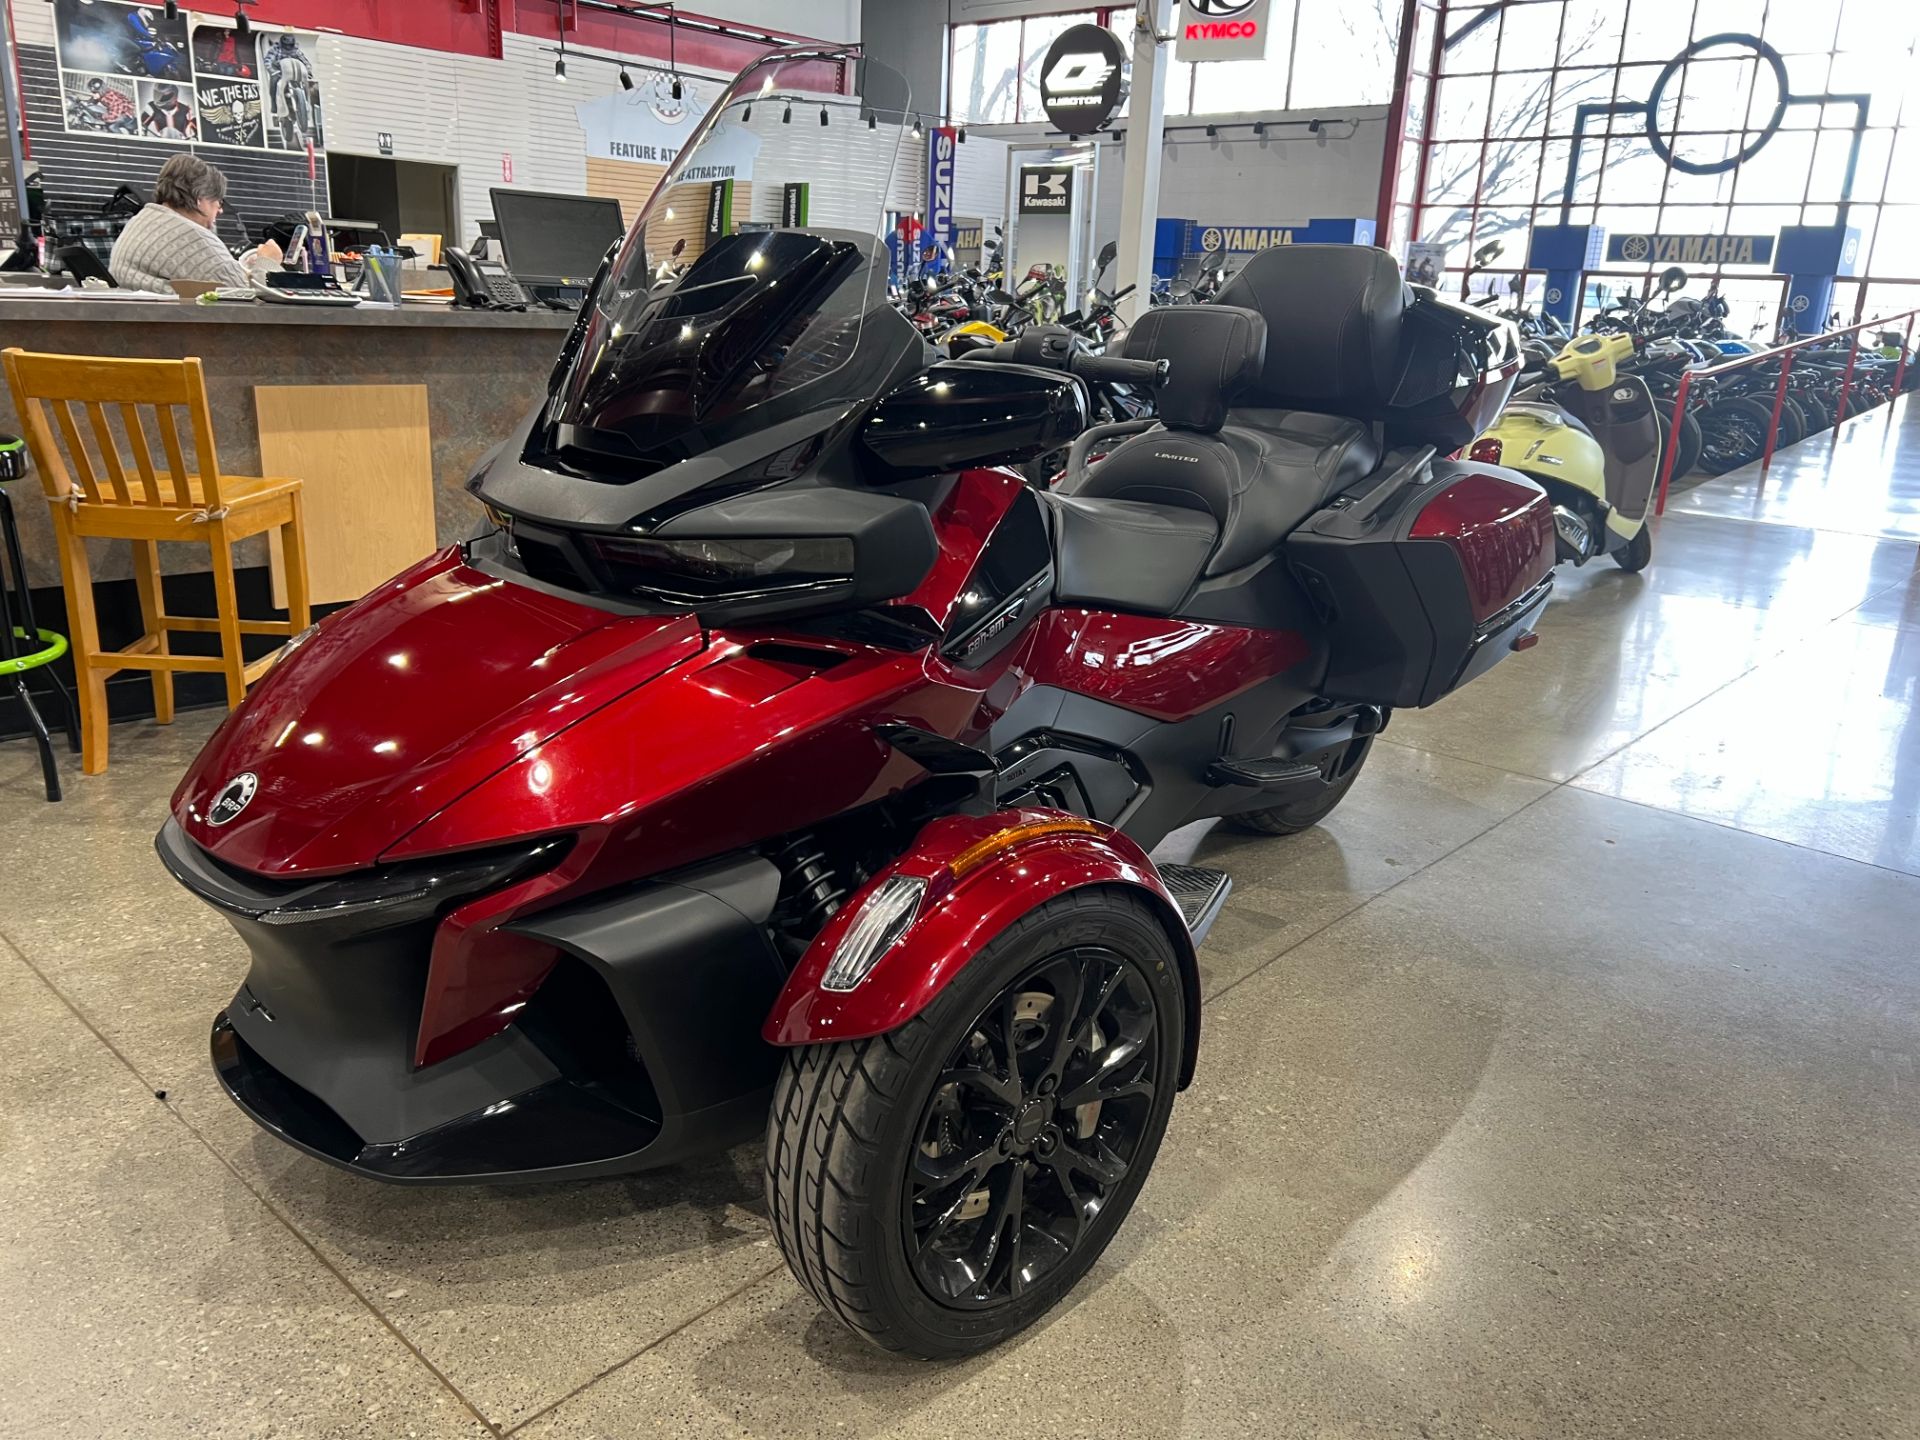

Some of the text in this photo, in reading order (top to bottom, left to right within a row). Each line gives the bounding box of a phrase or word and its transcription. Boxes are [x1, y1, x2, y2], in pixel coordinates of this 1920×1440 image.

[1185, 21, 1256, 40] KYMCO
[220, 85, 243, 103] THE
[610, 141, 656, 160] FEATURE
[685, 165, 735, 180] ATTRACTION
[711, 185, 722, 233] Kawasaki
[789, 188, 797, 228] awasaki
[1024, 197, 1066, 207] Kawasaki
[1222, 228, 1293, 251] YAMAHA
[1652, 236, 1753, 263] YAMAHA
[1154, 452, 1199, 463] LIMITED
[221, 797, 241, 812] BRP
